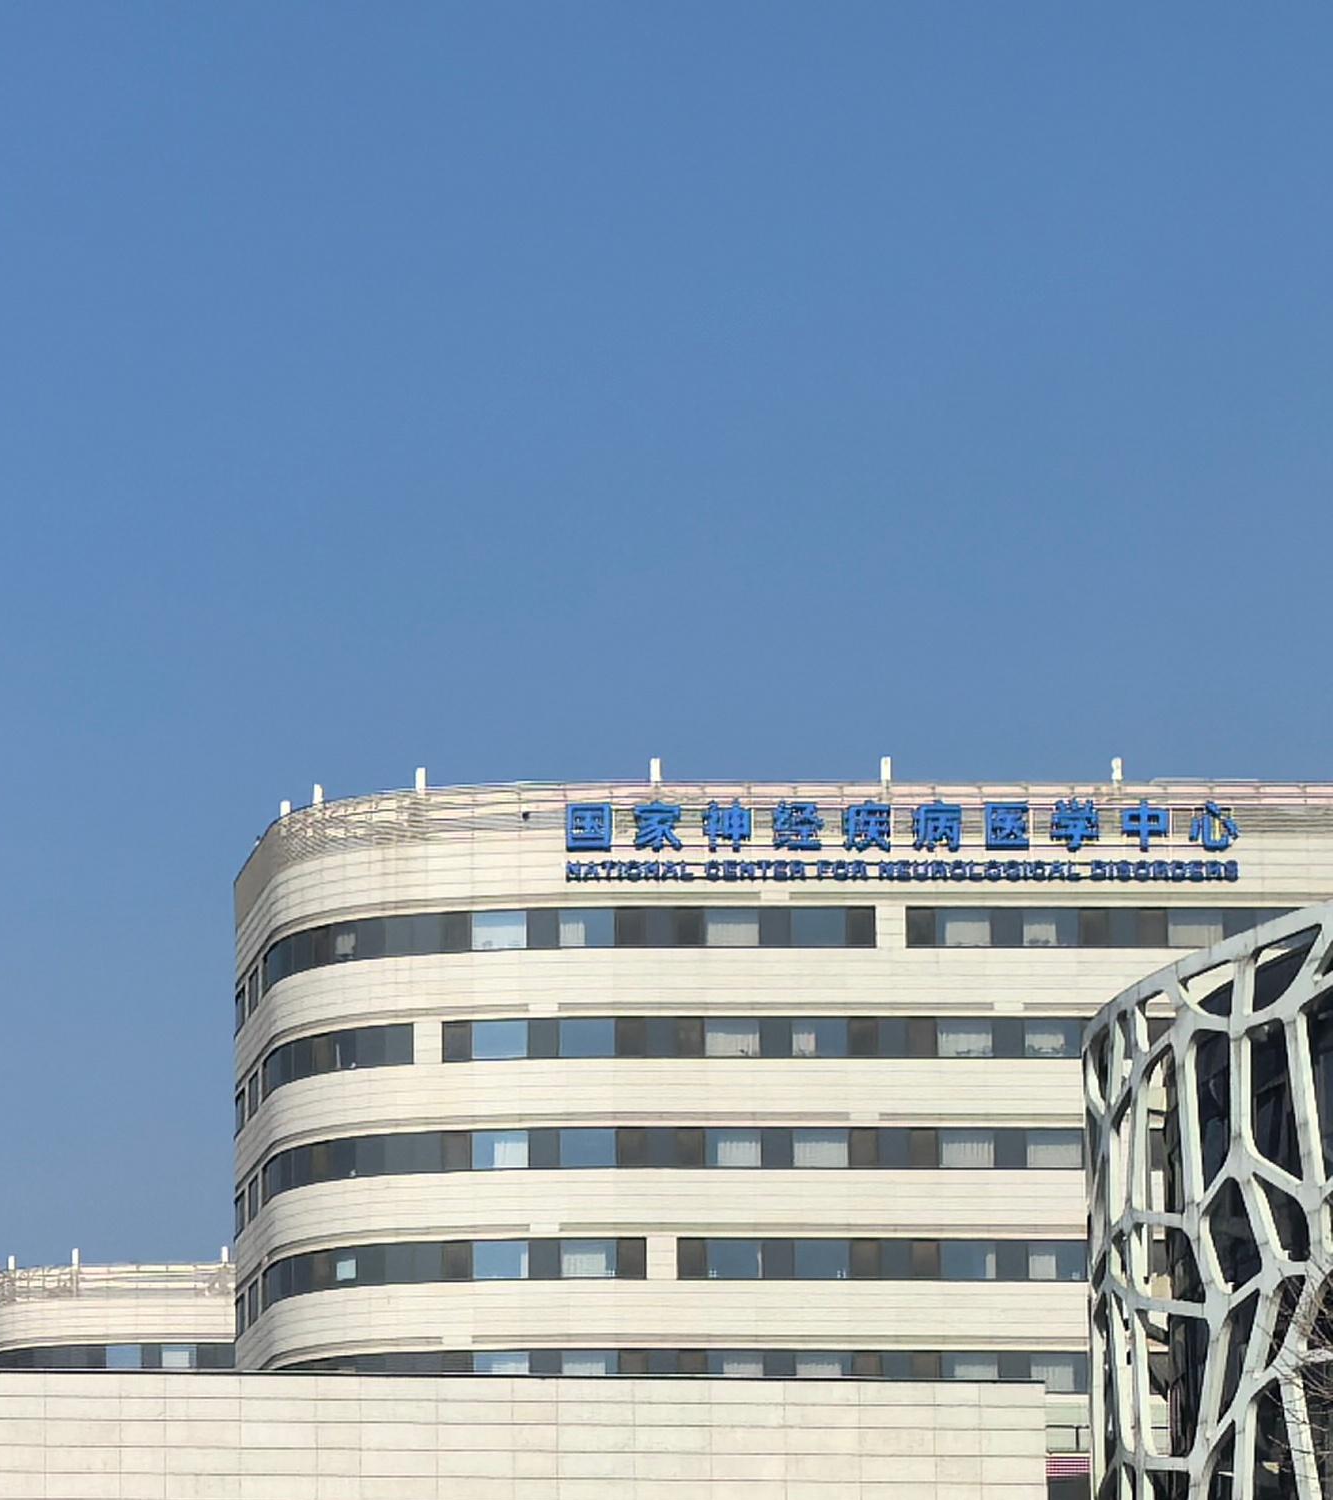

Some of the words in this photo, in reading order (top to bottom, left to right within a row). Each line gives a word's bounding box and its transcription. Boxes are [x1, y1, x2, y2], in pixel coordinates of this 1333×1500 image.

[565, 802, 1241, 853] 国家神经疾病医学中心
[566, 859, 694, 882] NATIONAL
[704, 859, 808, 882] CENTER
[816, 859, 867, 882] FOR
[878, 859, 1083, 882] NEUROLOGICAL
[1090, 859, 1240, 882] DISORDERS
